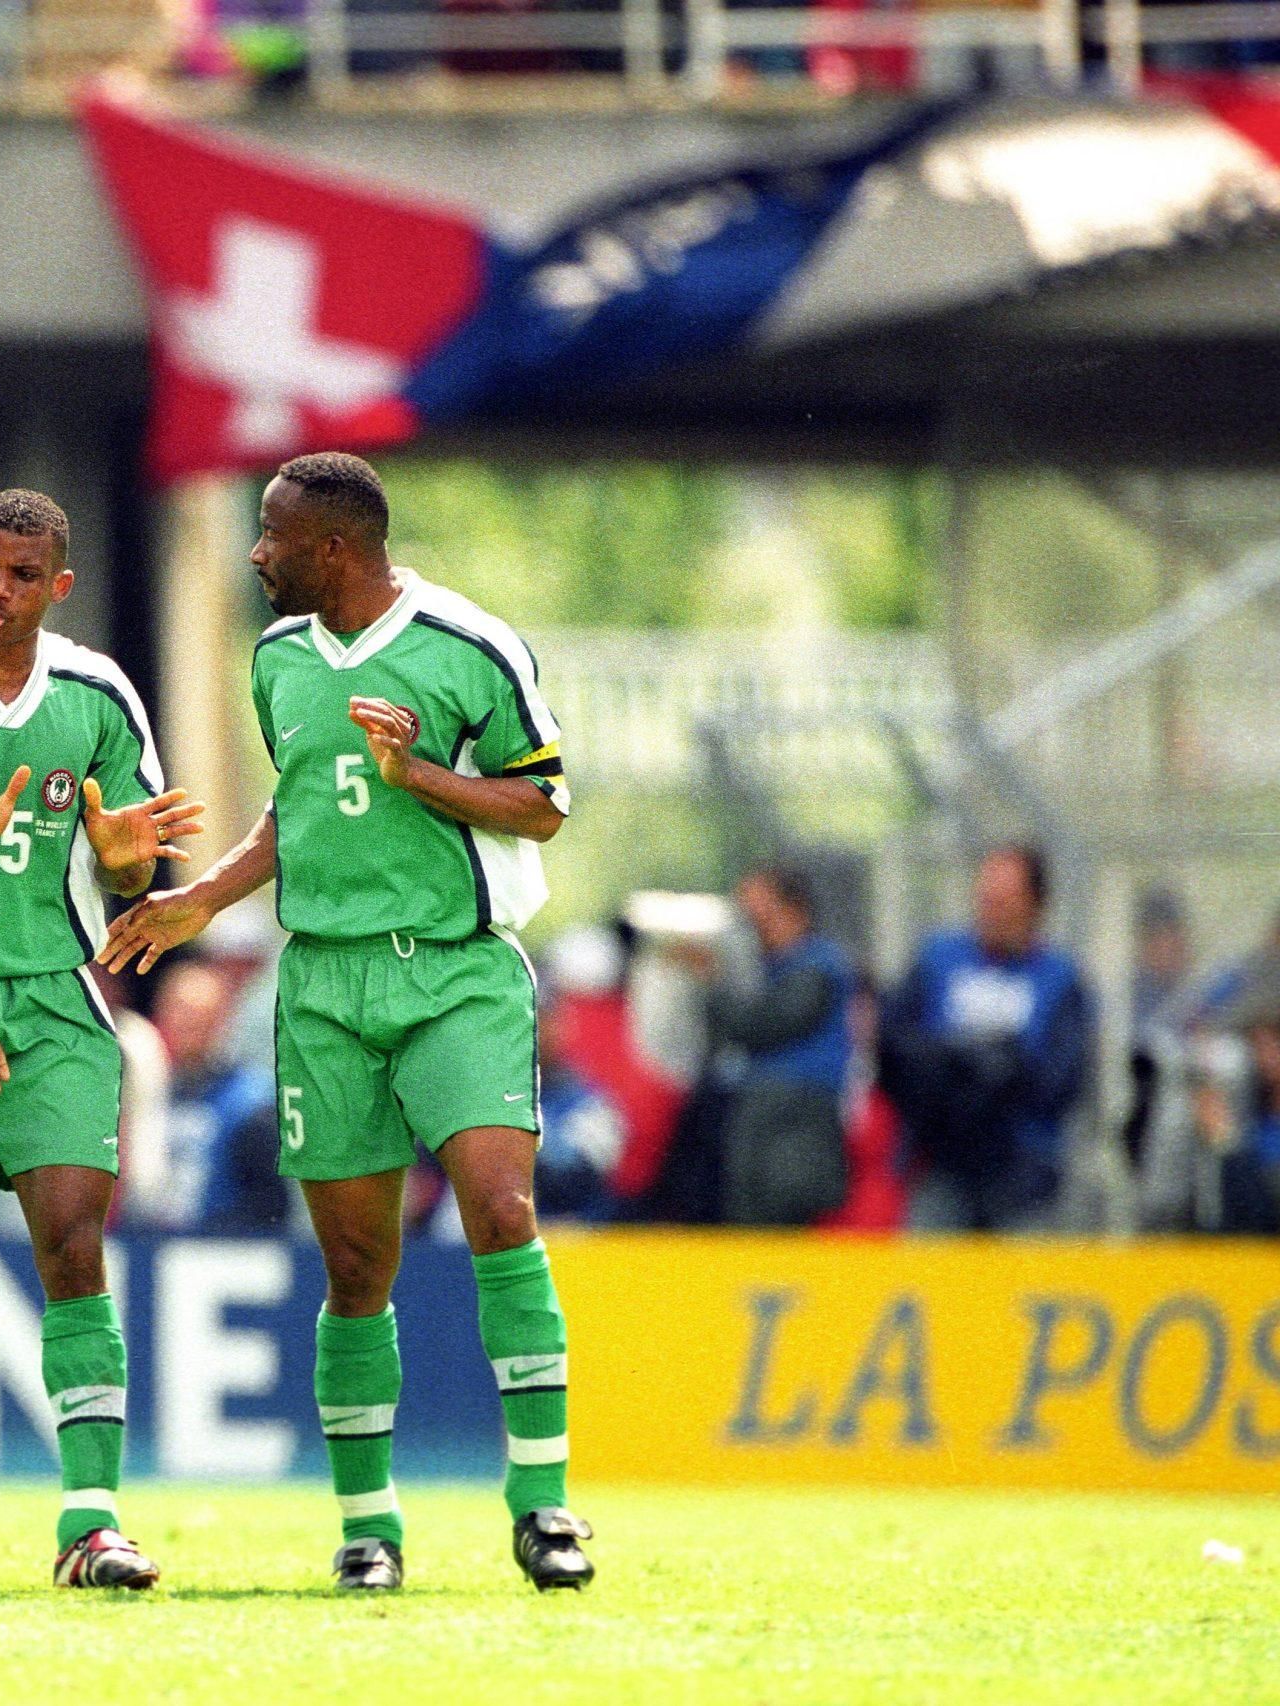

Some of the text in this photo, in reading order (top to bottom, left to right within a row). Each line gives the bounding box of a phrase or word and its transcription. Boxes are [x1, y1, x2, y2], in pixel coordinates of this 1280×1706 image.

[335, 754, 371, 817] 5
[284, 1085, 305, 1150] 5
[720, 1286, 939, 1449] LA
